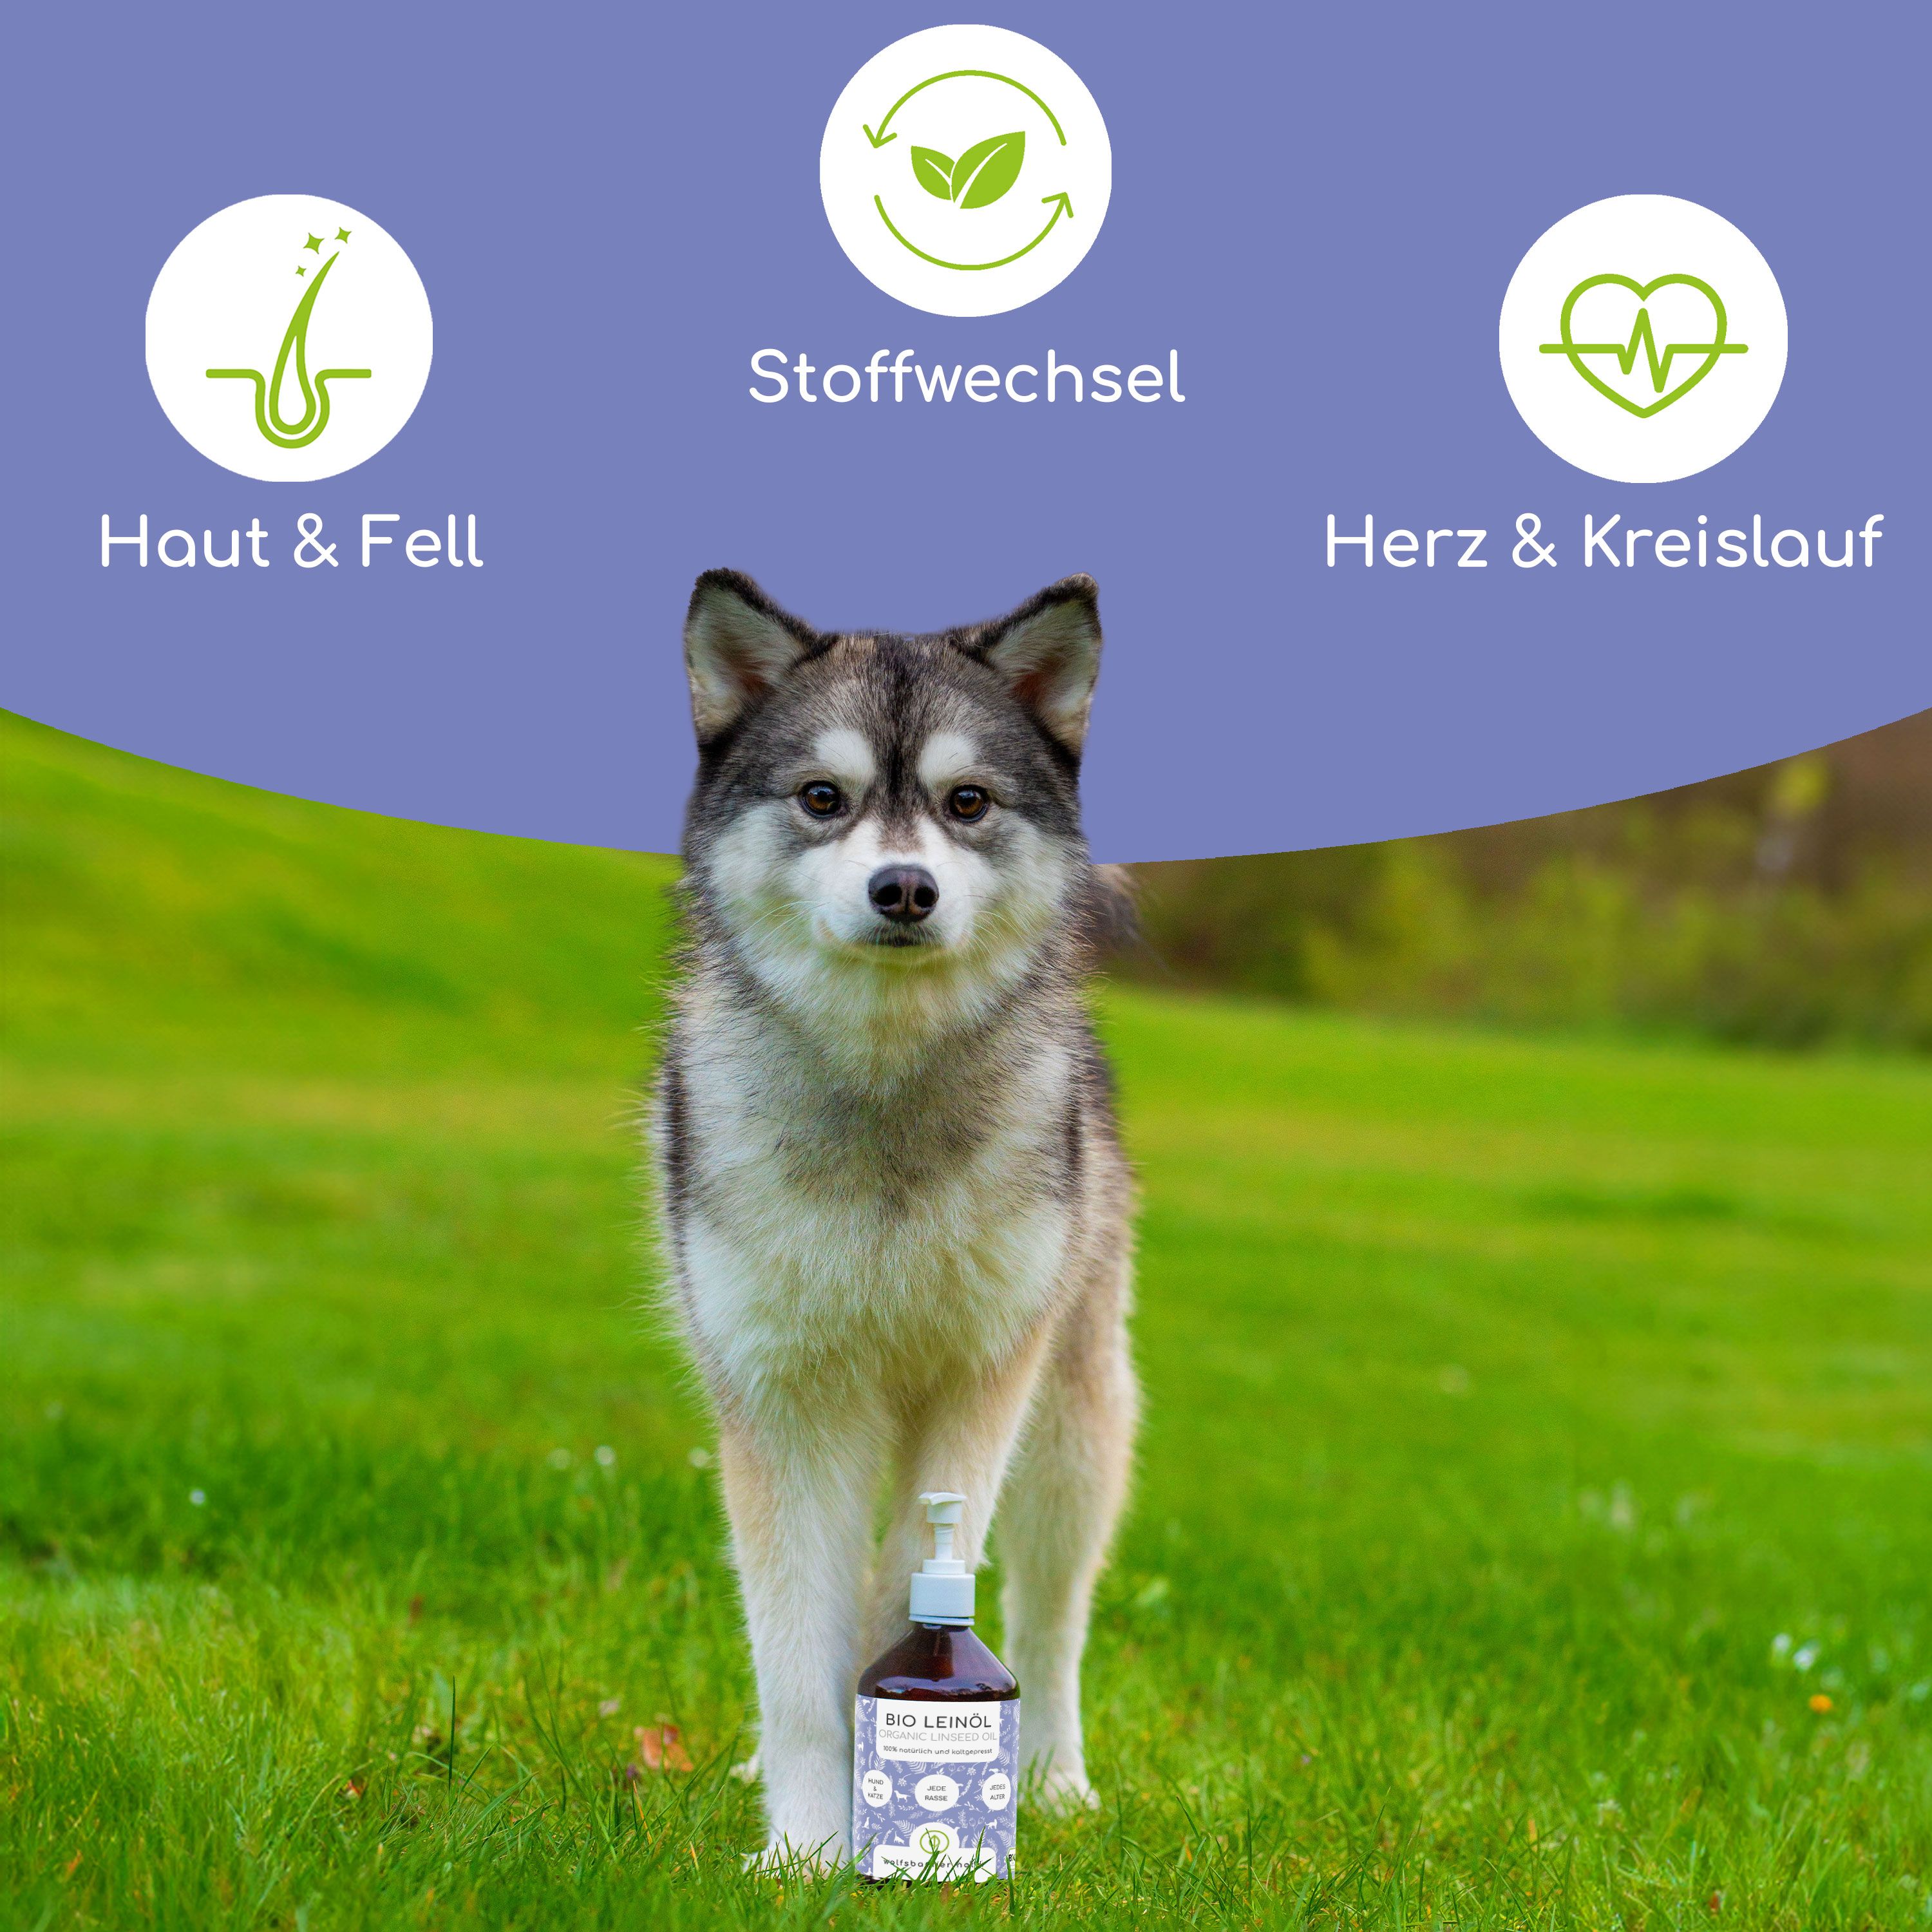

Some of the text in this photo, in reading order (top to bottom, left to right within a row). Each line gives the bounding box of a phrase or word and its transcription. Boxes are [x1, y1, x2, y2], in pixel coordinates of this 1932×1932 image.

[886, 1713, 992, 1728] BIO LEINÖL
[878, 1729, 998, 1742] ORGANIC LINSEED OIL
